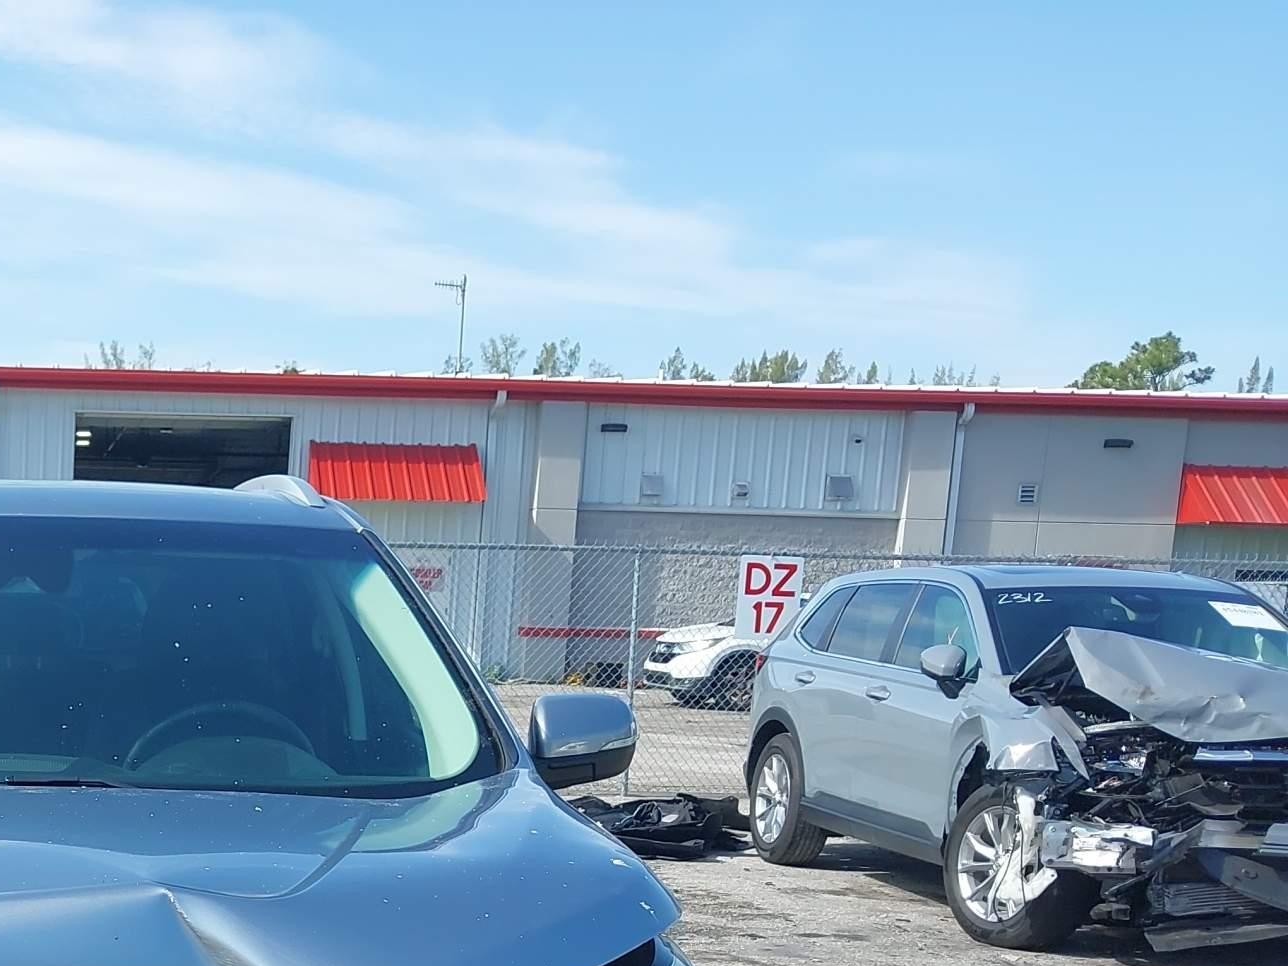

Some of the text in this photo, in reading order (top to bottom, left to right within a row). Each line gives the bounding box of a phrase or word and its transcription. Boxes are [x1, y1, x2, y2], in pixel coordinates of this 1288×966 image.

[744, 562, 798, 598] DZ
[997, 592, 1054, 605] 2312
[752, 601, 785, 634] 17
